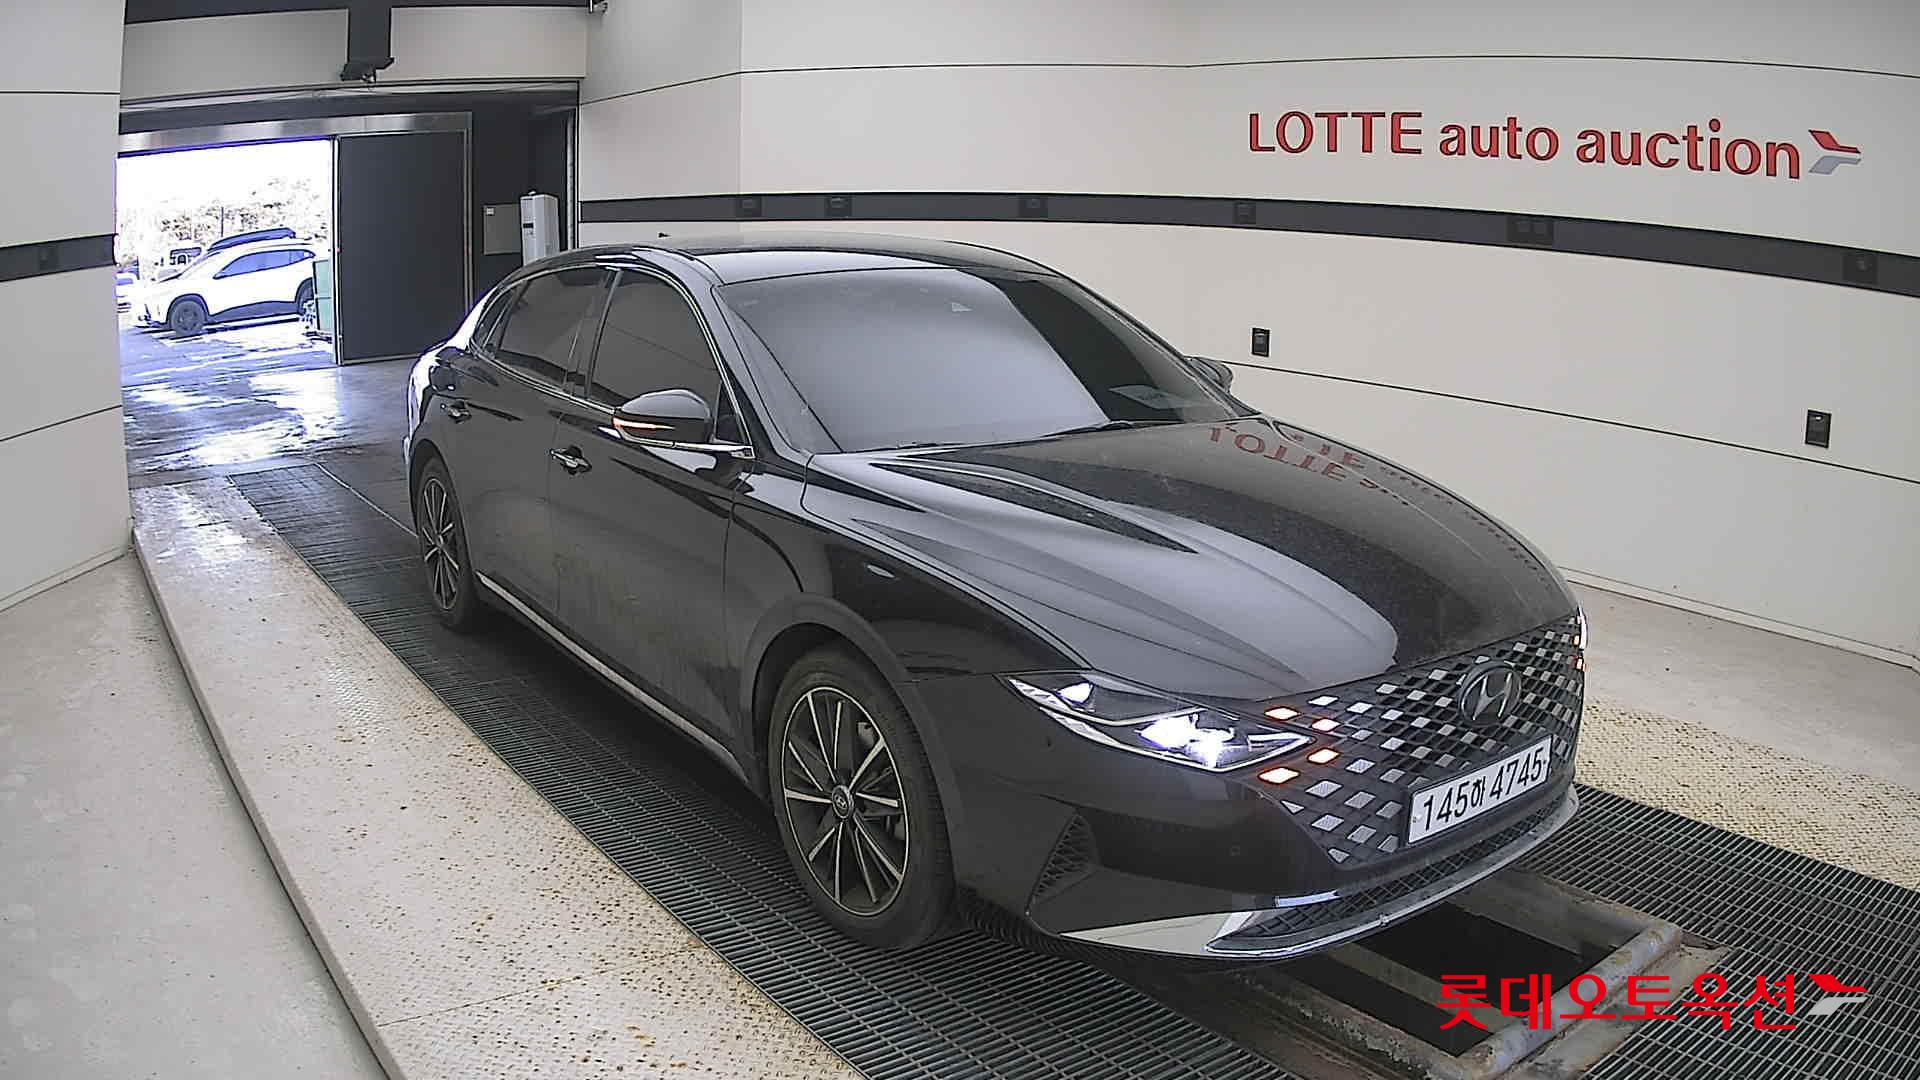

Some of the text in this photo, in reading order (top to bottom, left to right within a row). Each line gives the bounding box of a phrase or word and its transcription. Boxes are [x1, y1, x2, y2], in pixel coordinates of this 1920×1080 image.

[1249, 111, 1801, 179] LOTTE auto auction
[1423, 747, 1544, 831] 145하 4745
